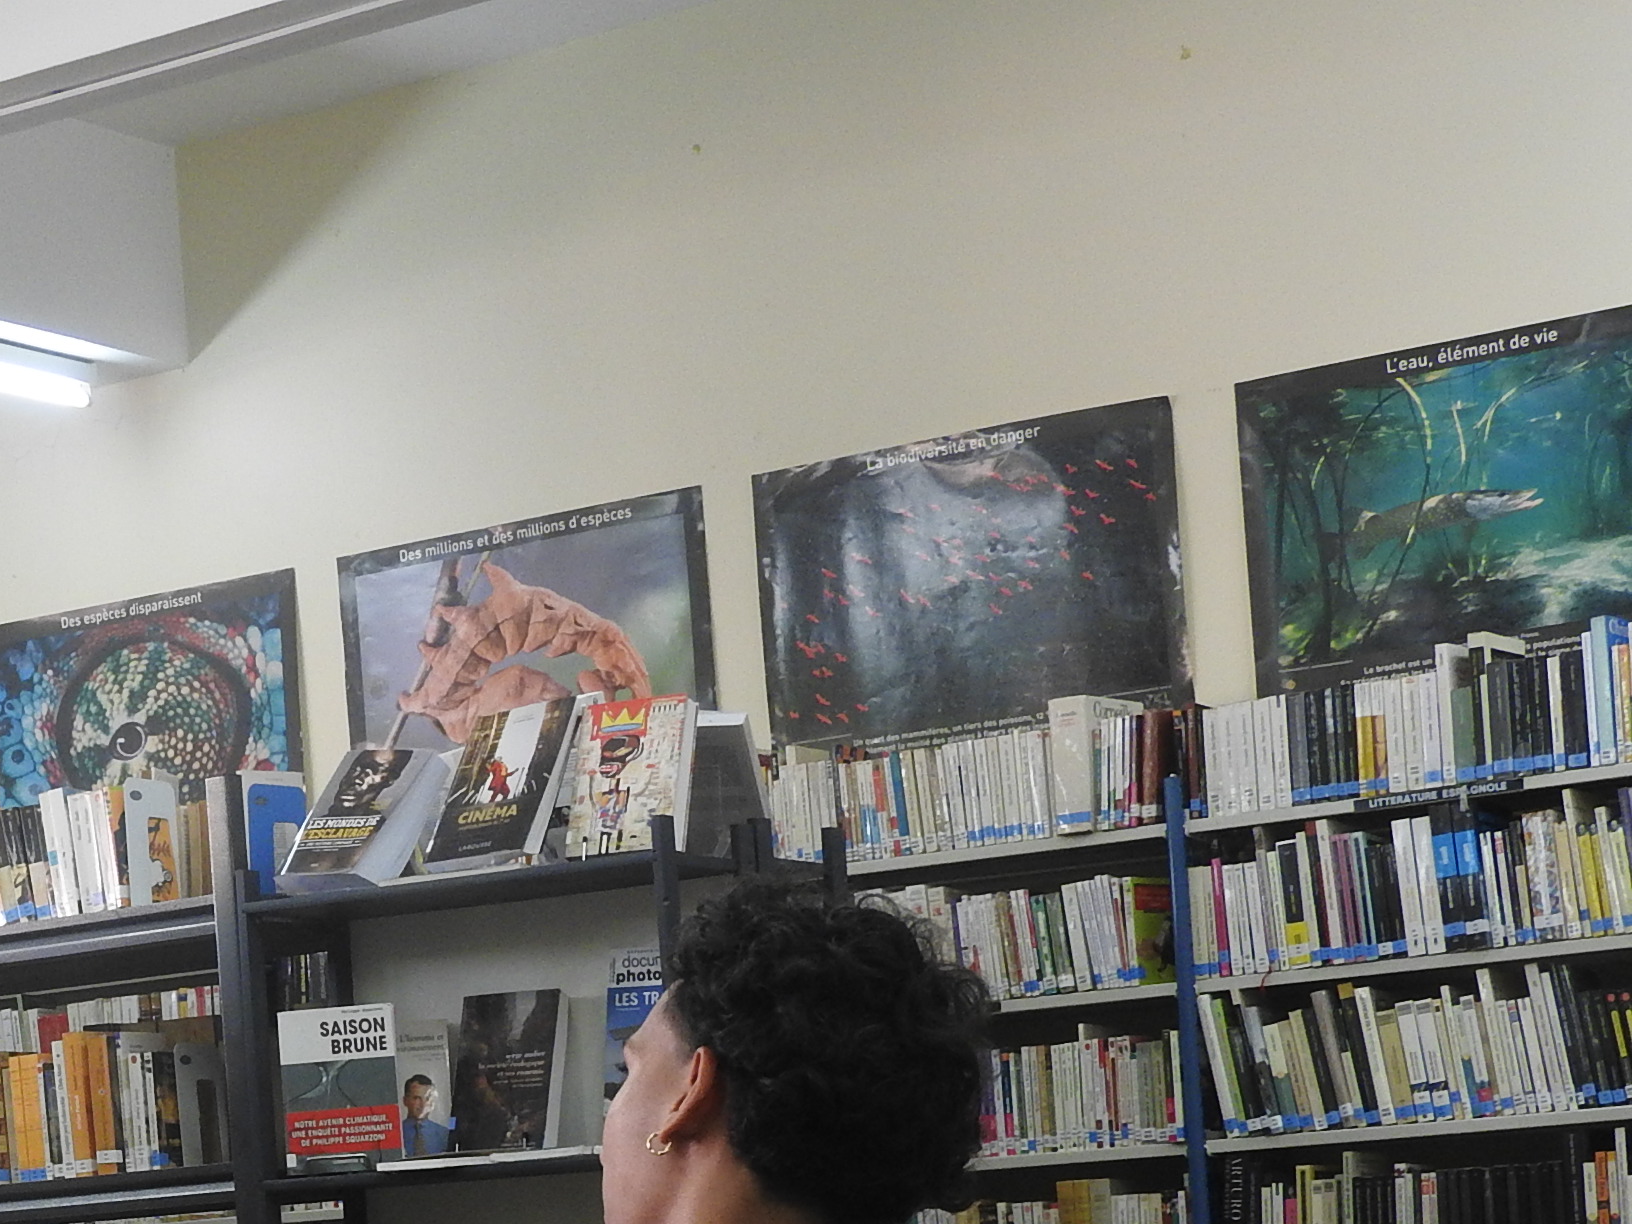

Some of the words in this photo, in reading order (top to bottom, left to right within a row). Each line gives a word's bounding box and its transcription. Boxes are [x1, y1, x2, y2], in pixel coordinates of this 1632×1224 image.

[1385, 355, 1433, 374] L'eau,
[1437, 337, 1505, 363] élément
[1509, 333, 1530, 349] de
[1533, 327, 1559, 346] vie
[866, 456, 884, 471] La
[887, 438, 967, 467] biodiversité
[968, 436, 987, 450] en
[990, 425, 1041, 449] danger
[399, 549, 422, 563] Des
[425, 538, 473, 558] millions
[477, 535, 489, 547] et
[492, 529, 514, 545] des
[516, 520, 566, 540] millions
[568, 506, 633, 530] d'espèces
[60, 614, 81, 629] Des
[83, 603, 127, 628] espèces
[129, 591, 203, 621] disparaissent
[325, 817, 366, 829] MONDES
[615, 992, 639, 1006] LES
[319, 1017, 386, 1037] SAISON
[331, 1035, 388, 1055] BRUNE
[294, 1119, 317, 1129] NOTRE
[318, 1117, 344, 1127] AVENIR
